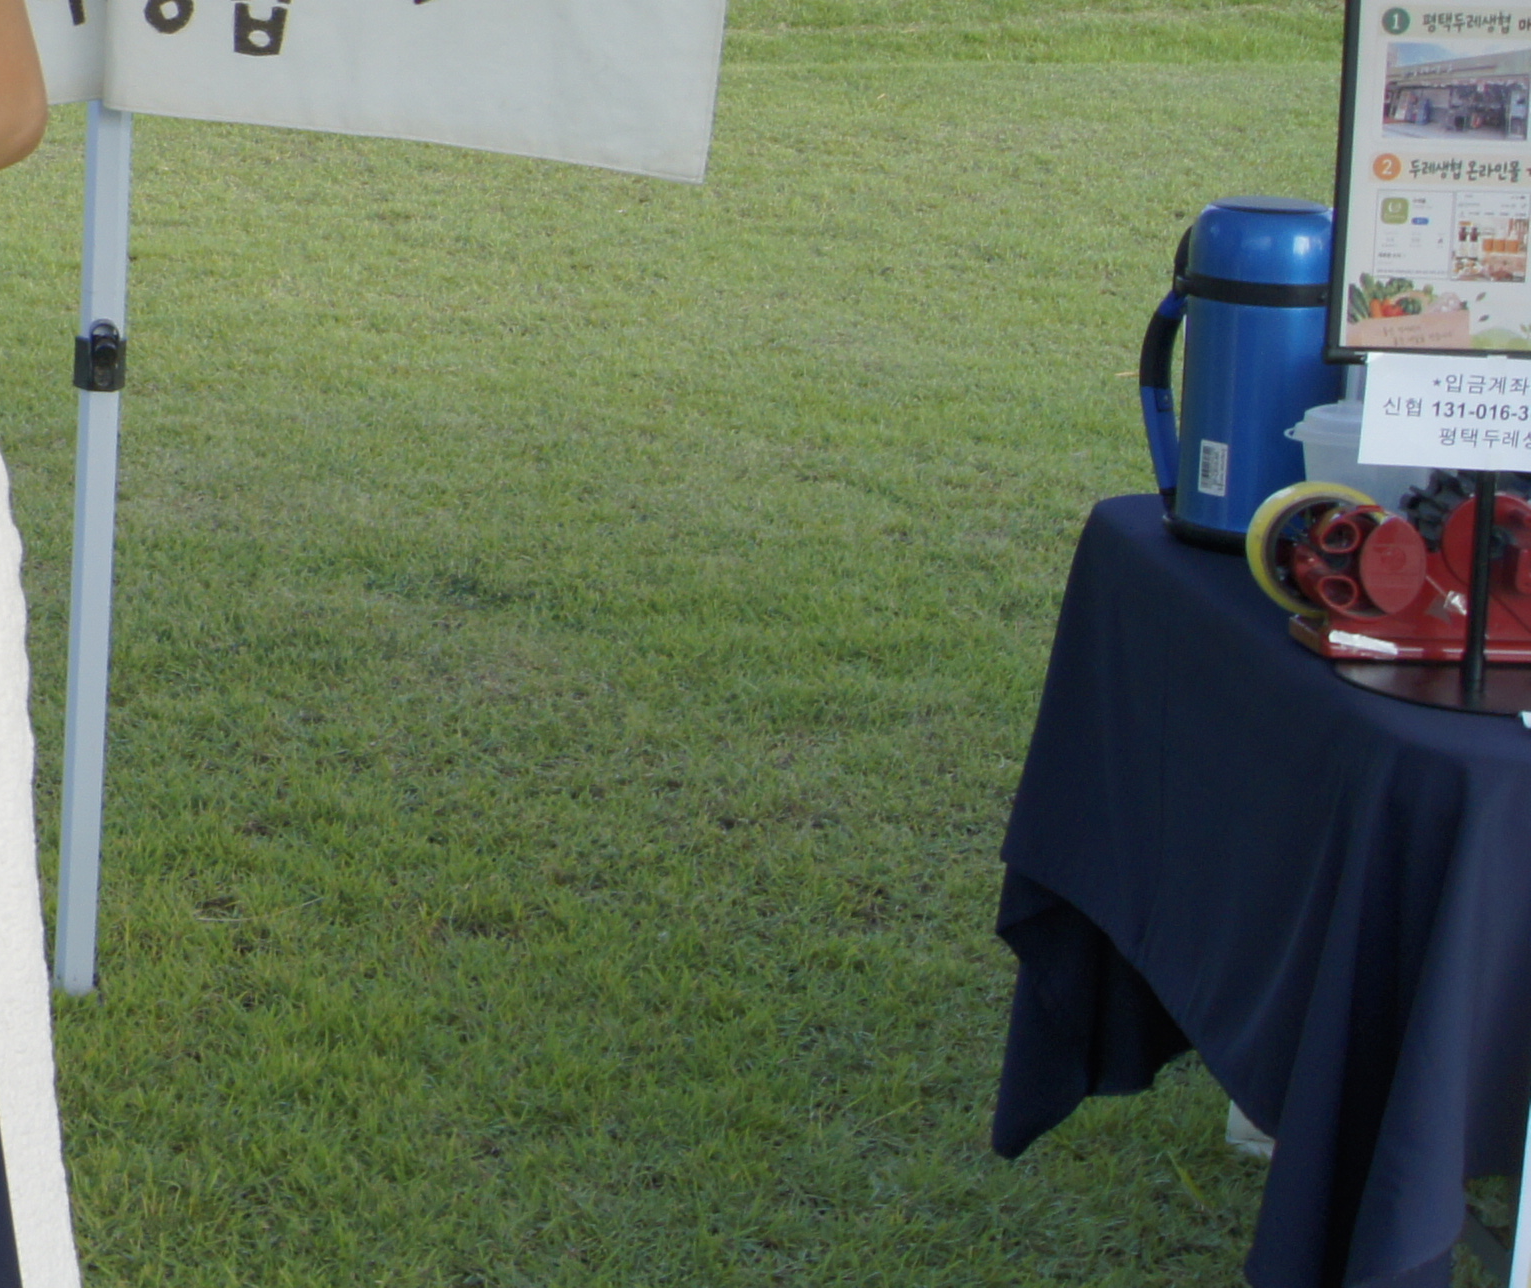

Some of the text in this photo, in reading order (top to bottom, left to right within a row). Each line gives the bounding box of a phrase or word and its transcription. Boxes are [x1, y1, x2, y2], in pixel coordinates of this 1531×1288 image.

[1422, 10, 1512, 35] 평택두레생협
[1409, 158, 1462, 181] 두레생협
[1466, 159, 1521, 183] 온라인몰
[1382, 397, 1423, 418] 신협
